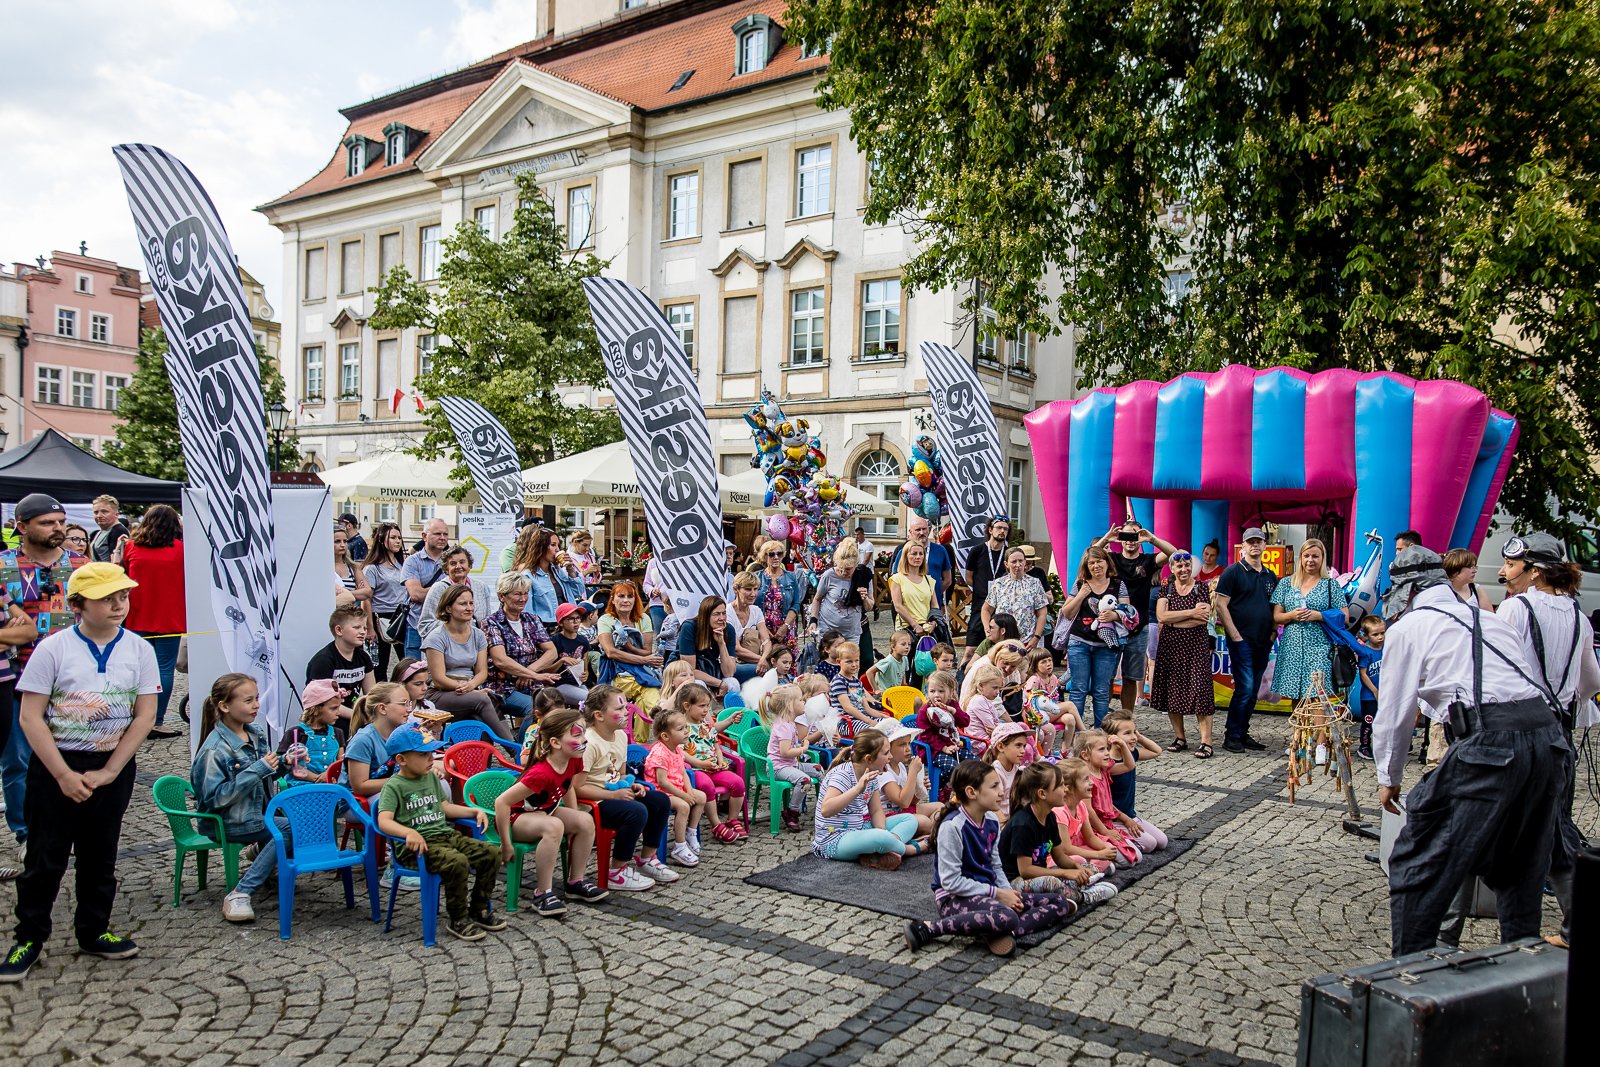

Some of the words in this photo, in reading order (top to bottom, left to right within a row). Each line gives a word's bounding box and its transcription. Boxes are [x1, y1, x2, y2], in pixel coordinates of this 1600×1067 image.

[380, 488, 437, 498] PIWNICZKA
[522, 482, 550, 493] Kozel
[611, 483, 640, 493] PIWN
[730, 491, 750, 503] Kozel
[1261, 550, 1280, 563] OP
